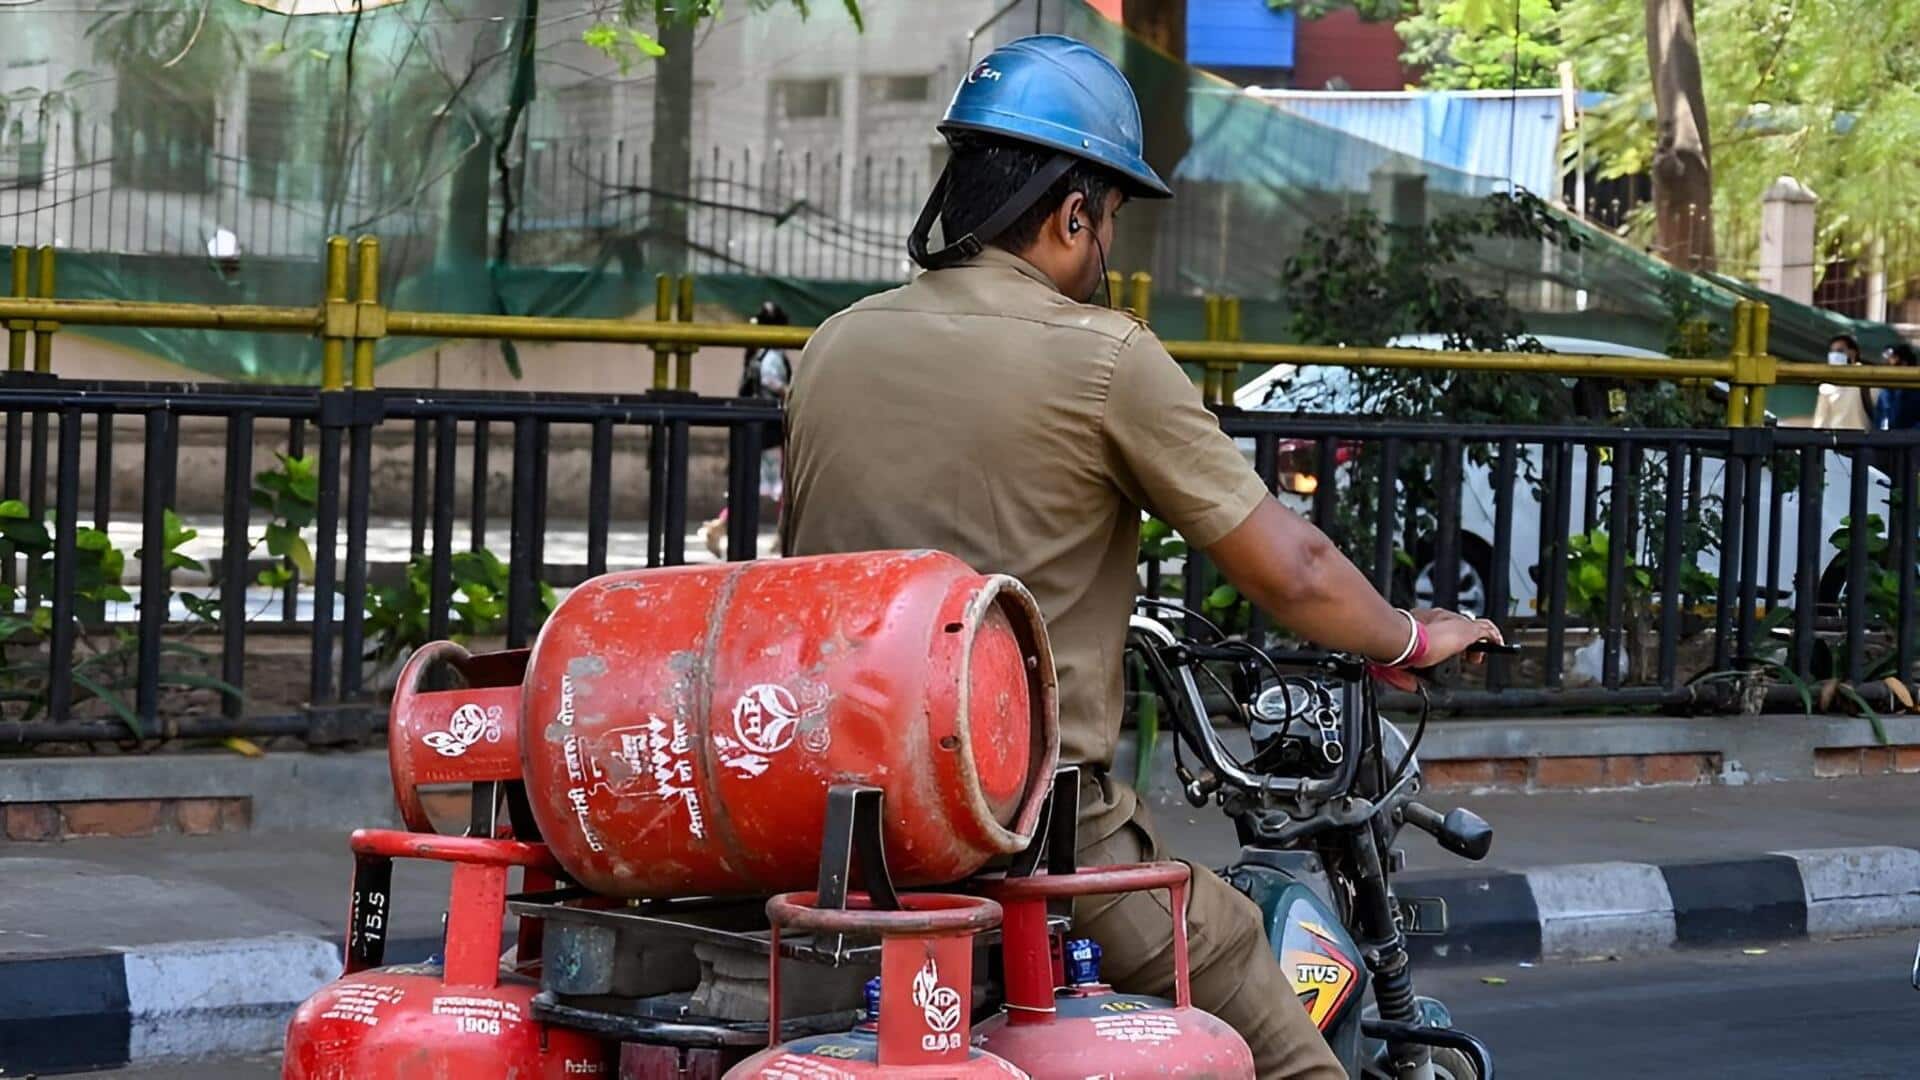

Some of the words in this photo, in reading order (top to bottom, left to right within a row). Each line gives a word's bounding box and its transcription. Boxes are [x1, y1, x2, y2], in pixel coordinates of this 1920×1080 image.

[364, 891, 385, 942] 15.5
[1296, 964, 1340, 984] TVS
[456, 1017, 500, 1036] 1906
